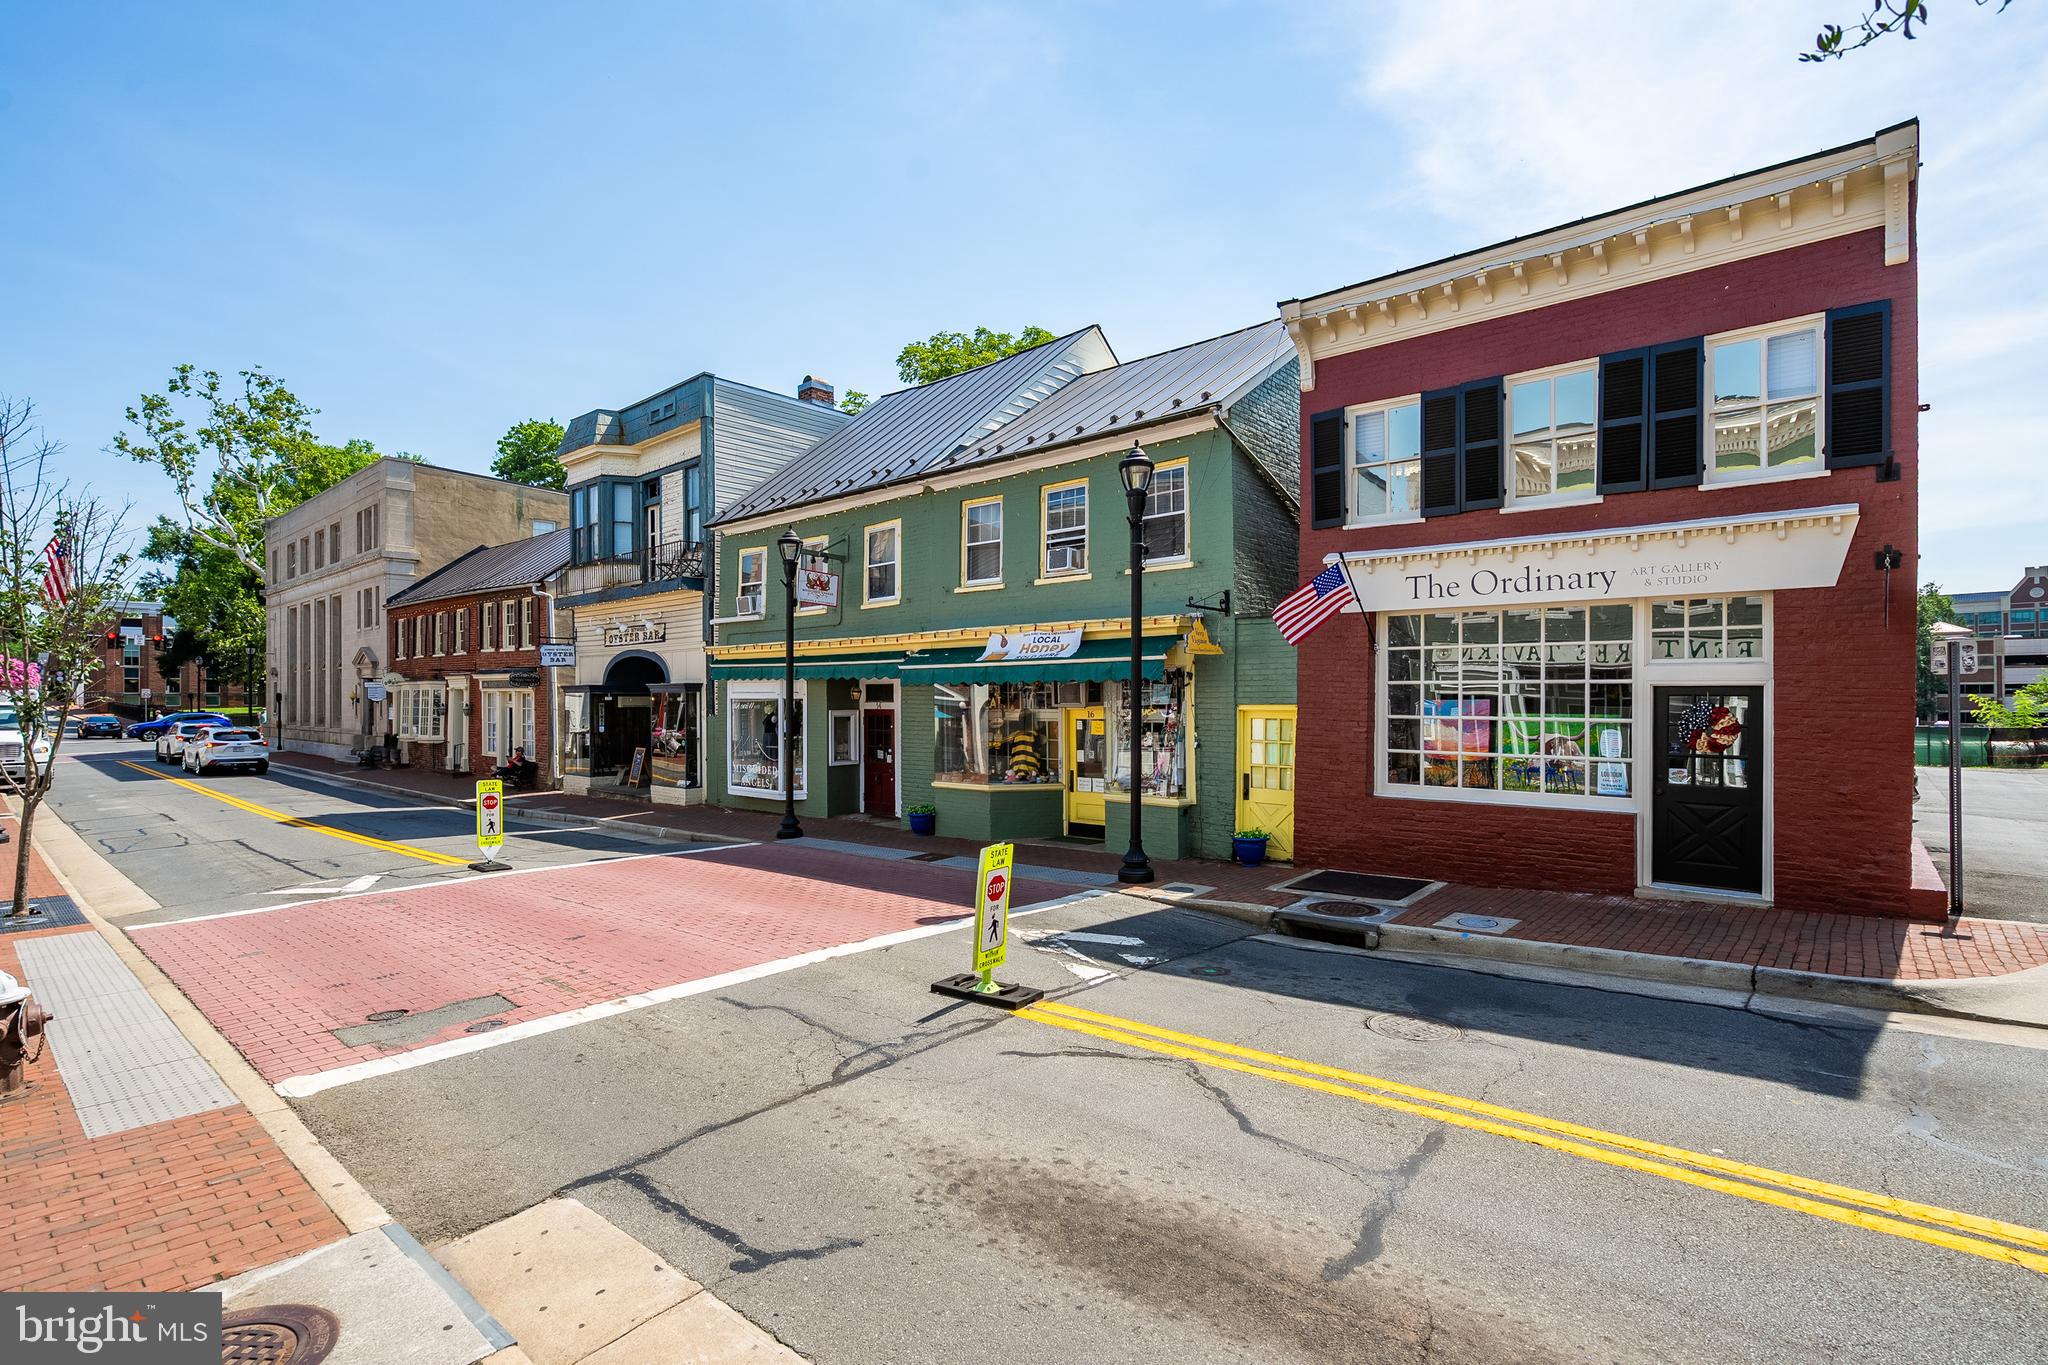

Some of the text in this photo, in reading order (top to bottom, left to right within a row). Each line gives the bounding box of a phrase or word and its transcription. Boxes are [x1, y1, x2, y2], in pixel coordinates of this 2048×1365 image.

[1630, 561, 1722, 579] ART GALLERY
[1405, 565, 1617, 600] The Ordinary
[1644, 576, 1708, 590] & STUDIO
[609, 630, 660, 643] OYSTER BAR
[1019, 643, 1070, 654] Honey
[741, 777, 770, 788] ANGELS
[991, 848, 1008, 858] STATE
[992, 859, 1005, 868] LAW
[988, 882, 1005, 895] STOP
[979, 956, 1004, 969] CROSSWALK
